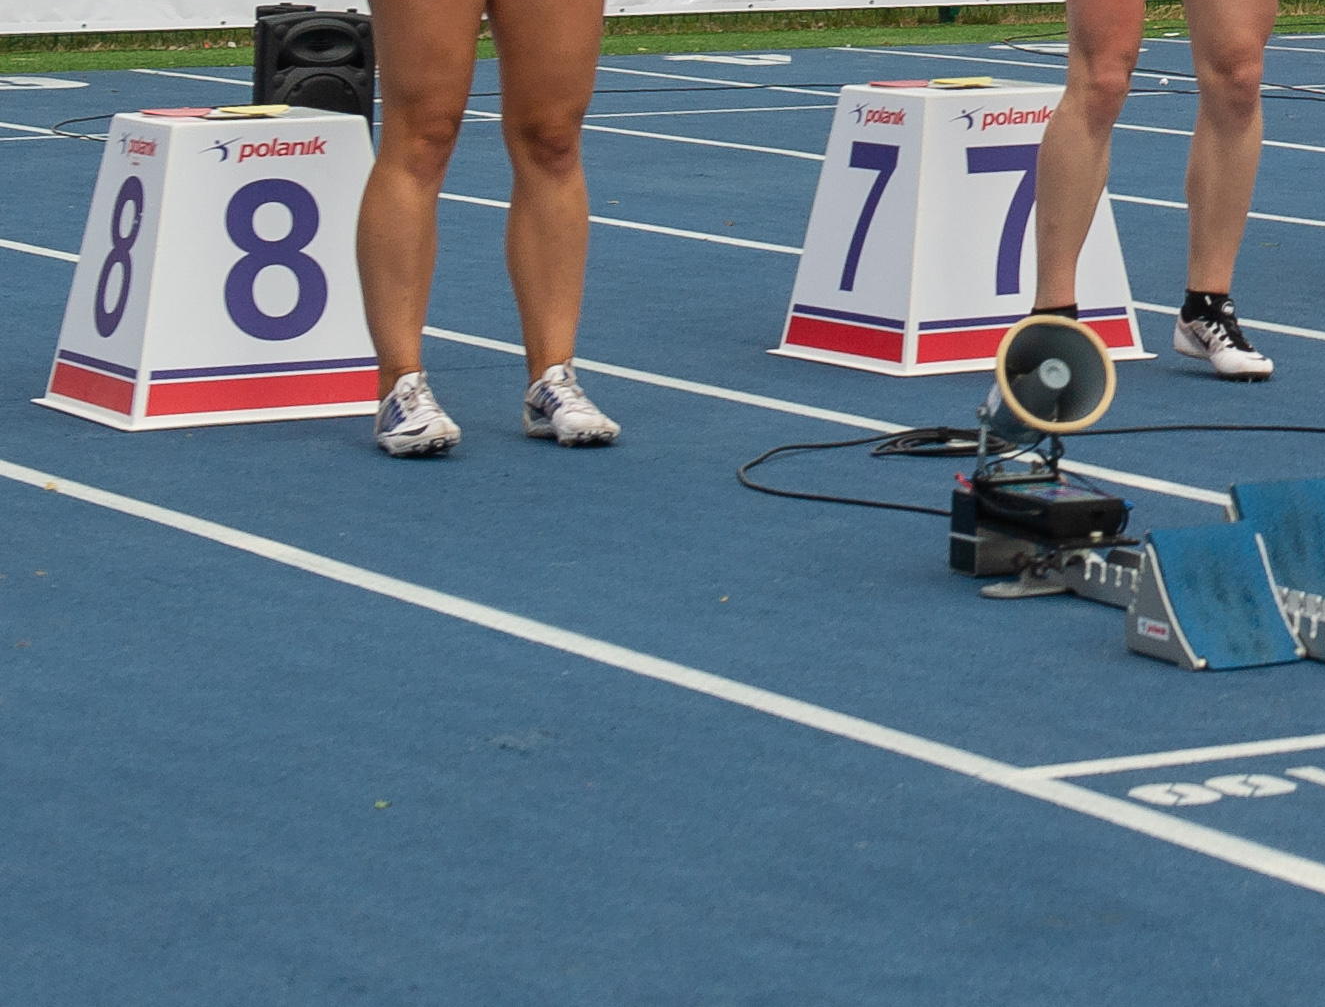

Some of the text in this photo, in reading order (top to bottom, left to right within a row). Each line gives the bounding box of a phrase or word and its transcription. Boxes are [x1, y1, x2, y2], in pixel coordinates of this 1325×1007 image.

[237, 136, 327, 164] polanik
[863, 105, 906, 127] polanik
[981, 105, 1055, 131] polanik
[94, 175, 144, 338] 8
[224, 178, 328, 341] 8
[848, 141, 900, 292] 7
[966, 143, 1042, 296] 7
